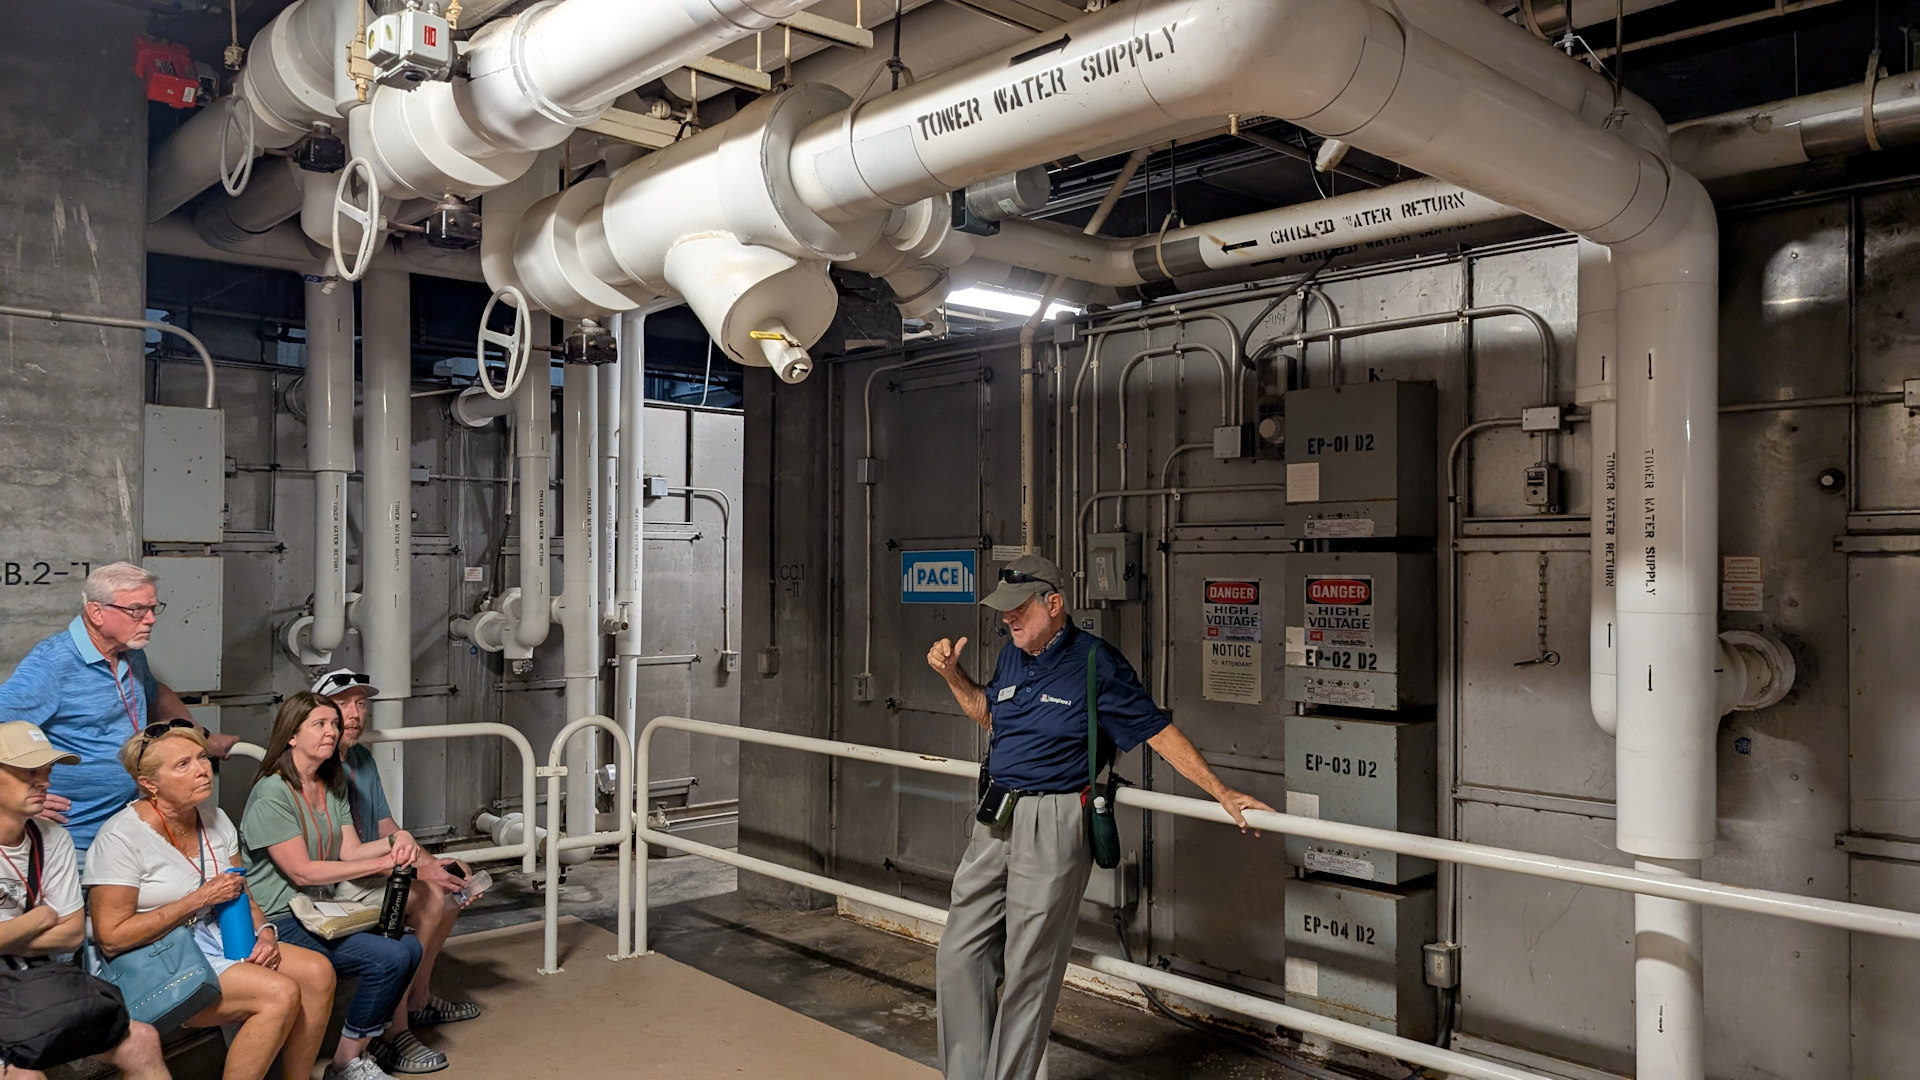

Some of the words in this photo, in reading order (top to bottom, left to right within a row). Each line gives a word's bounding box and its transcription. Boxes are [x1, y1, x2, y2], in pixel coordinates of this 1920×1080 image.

[917, 97, 983, 141] TOWER
[993, 66, 1067, 115] WATER
[1080, 22, 1178, 83] SUPPLY
[1270, 218, 1336, 245] CHILLED
[1342, 207, 1393, 228] WATER
[1401, 192, 1466, 218] RETURN
[1355, 433, 1375, 452] D2
[1606, 452, 1616, 490] TOWER
[1644, 448, 1655, 489] TOWER
[1605, 497, 1616, 535] WATER
[1644, 497, 1655, 539] WATER
[1605, 542, 1615, 587] RETURN
[1645, 546, 1656, 596] SUPPLY
[917, 568, 960, 586] PACE
[1209, 586, 1255, 600] DANGER
[1312, 584, 1366, 599] DANGER
[1206, 614, 1258, 627] VOLTAGE
[1214, 605, 1249, 615] HIGH
[1318, 606, 1359, 616] HIGH
[1308, 616, 1371, 630] VOLTAGE
[1212, 643, 1252, 658] NOTICE
[1305, 649, 1352, 669] EP-02
[1358, 651, 1378, 671] D2
[1305, 753, 1351, 775] EP-03
[1358, 758, 1377, 779] D2
[1304, 914, 1349, 940] EP-04
[1356, 924, 1376, 945] D2
